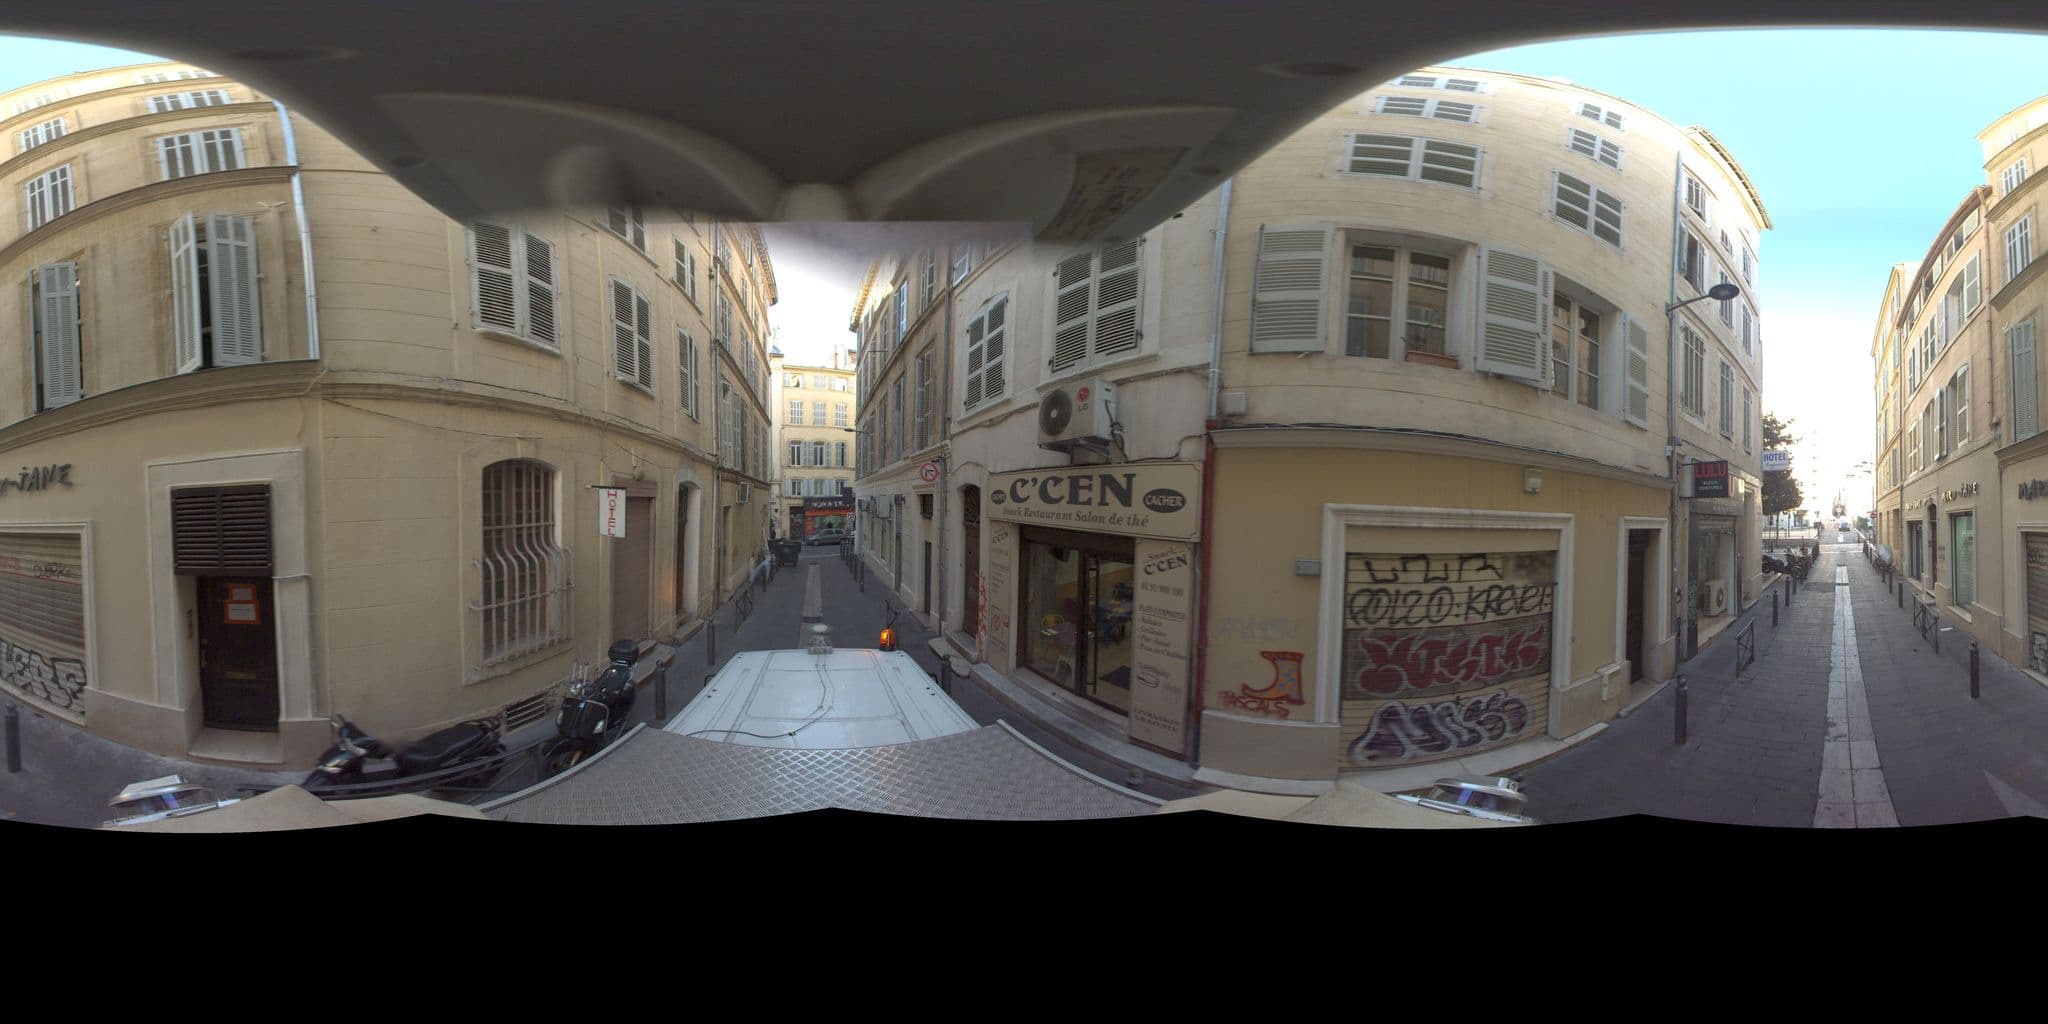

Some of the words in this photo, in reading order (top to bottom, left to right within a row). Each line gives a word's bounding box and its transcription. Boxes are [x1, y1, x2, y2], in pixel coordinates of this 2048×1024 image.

[1763, 453, 1786, 461] HOTEL
[1695, 463, 1727, 478] LULU
[1009, 473, 1136, 507] C'CEN
[608, 490, 617, 537] HOTEL
[1024, 507, 1072, 521] Restaurant
[1075, 510, 1105, 525] Salon
[1109, 512, 1123, 526] de
[1127, 512, 1149, 527] thé
[1144, 554, 1188, 575] C'CEN
